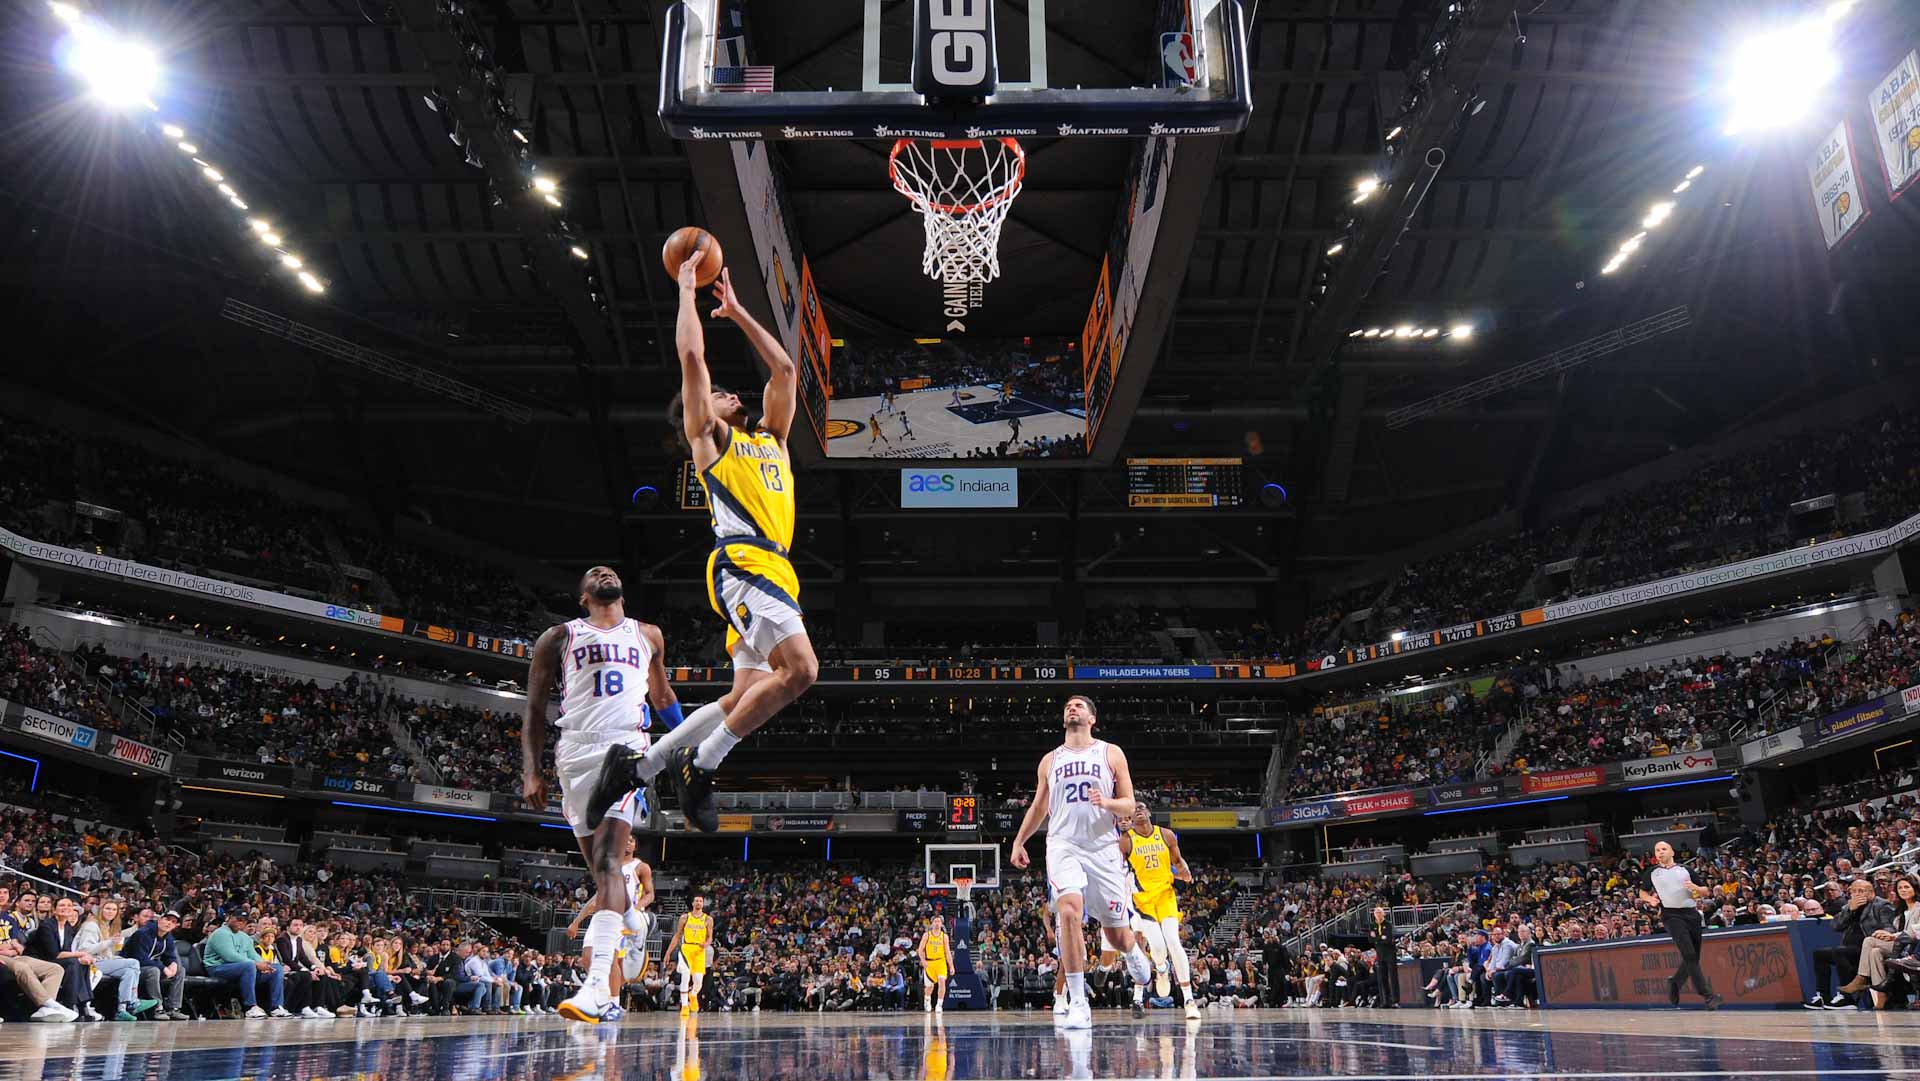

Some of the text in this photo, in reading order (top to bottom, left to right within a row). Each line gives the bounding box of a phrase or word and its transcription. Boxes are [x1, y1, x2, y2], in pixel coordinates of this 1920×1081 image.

[1880, 68, 1912, 105] ABA
[690, 126, 762, 139] DRAFTKINGS
[782, 126, 854, 139] DRAFTKINGS
[874, 124, 945, 138] DRAFTKINGS
[966, 126, 1037, 138] DRAFTKINGS
[1057, 123, 1129, 136] DRAFTKINGS
[1149, 122, 1220, 135] DRAFTKINGS
[1815, 138, 1841, 171] ABA
[1821, 170, 1850, 207] 1969-70
[760, 462, 784, 492] 13
[908, 474, 1010, 493] aes Indiana
[29, 544, 84, 567] energy,
[88, 557, 122, 572] right
[125, 562, 158, 581] here
[160, 569, 171, 583] in
[174, 572, 256, 601] Indianapolis.
[1558, 603, 1577, 616] the
[1579, 593, 1620, 612] world's
[1622, 580, 1679, 602] transition
[1681, 577, 1695, 590] to
[1753, 553, 1809, 573] smarter
[1811, 540, 1866, 562] energy,
[1869, 529, 1901, 549] right
[325, 603, 356, 622] aes
[1488, 620, 1516, 633] 13/29
[1446, 629, 1472, 642] 14/18
[477, 640, 488, 650] 30
[502, 646, 513, 655] 23
[1404, 638, 1430, 651] 41/68
[572, 643, 640, 671] PHILA
[1356, 653, 1368, 662] 26
[1379, 647, 1390, 657] 21
[874, 668, 890, 680] 95
[949, 668, 981, 680] 10:28
[1034, 667, 1056, 679] 109
[1099, 667, 1190, 677] PHILADELPHIA 76ERS
[593, 670, 624, 697] 18
[1831, 708, 1885, 733] planet fitness
[25, 714, 91, 743] SECTION 127
[114, 738, 169, 769] POINTSBET
[222, 767, 264, 780] verizon
[1055, 760, 1102, 784] PHILA
[1624, 760, 1682, 778] KeyBank
[445, 790, 473, 802] slack
[1065, 781, 1092, 803] 20
[953, 797, 975, 807] 10:28
[1347, 800, 1374, 812] STEAK
[1380, 796, 1409, 808] SHAKE
[951, 806, 973, 823] 21
[913, 821, 921, 829] 95
[1000, 820, 1012, 828] 109
[1134, 843, 1165, 857] INDIANA
[1144, 854, 1159, 869] 25
[1109, 901, 1123, 913] 76
